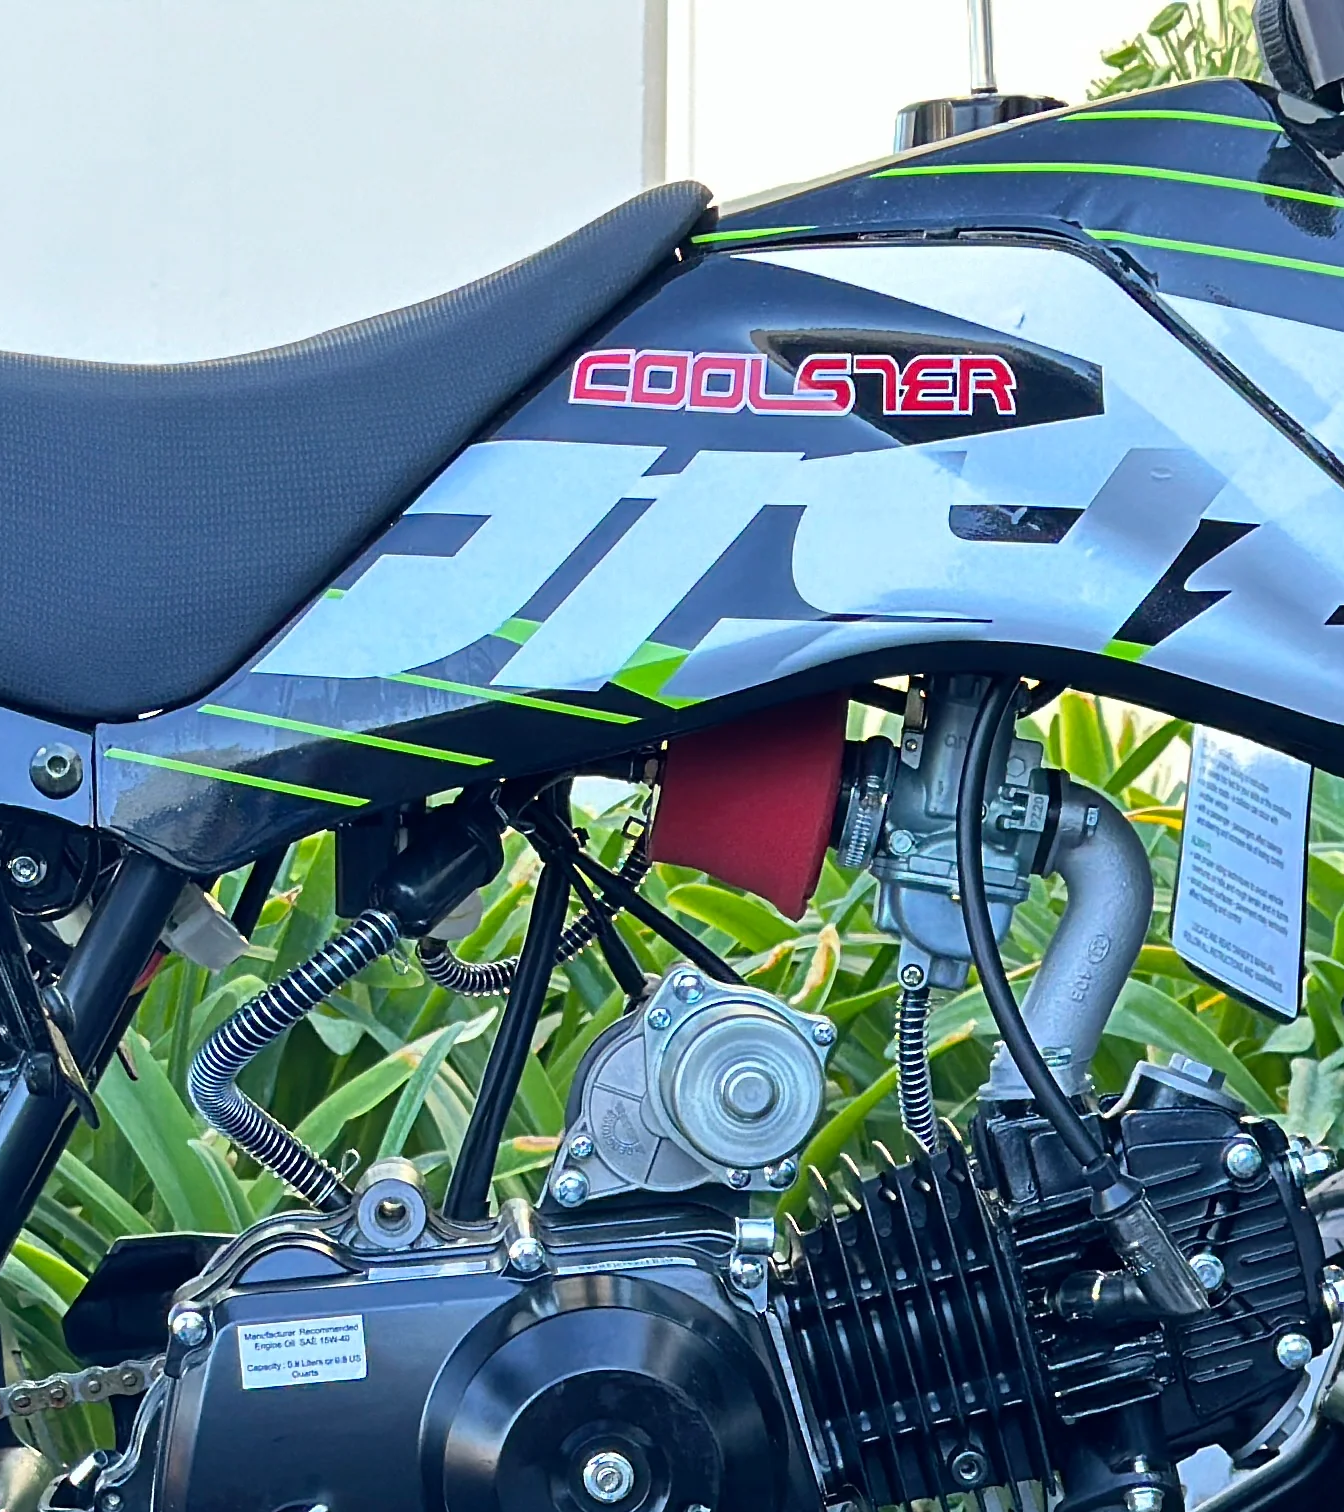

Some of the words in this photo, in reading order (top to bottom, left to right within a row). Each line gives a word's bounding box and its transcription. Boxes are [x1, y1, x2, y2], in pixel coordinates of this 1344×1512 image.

[568, 349, 1016, 416] COOLSTER
[244, 1329, 296, 1340] Manufacturer
[299, 1324, 359, 1336] Recommended
[254, 1341, 282, 1351] Engine
[299, 1337, 317, 1347] SAE
[291, 1369, 319, 1379] Quarts
